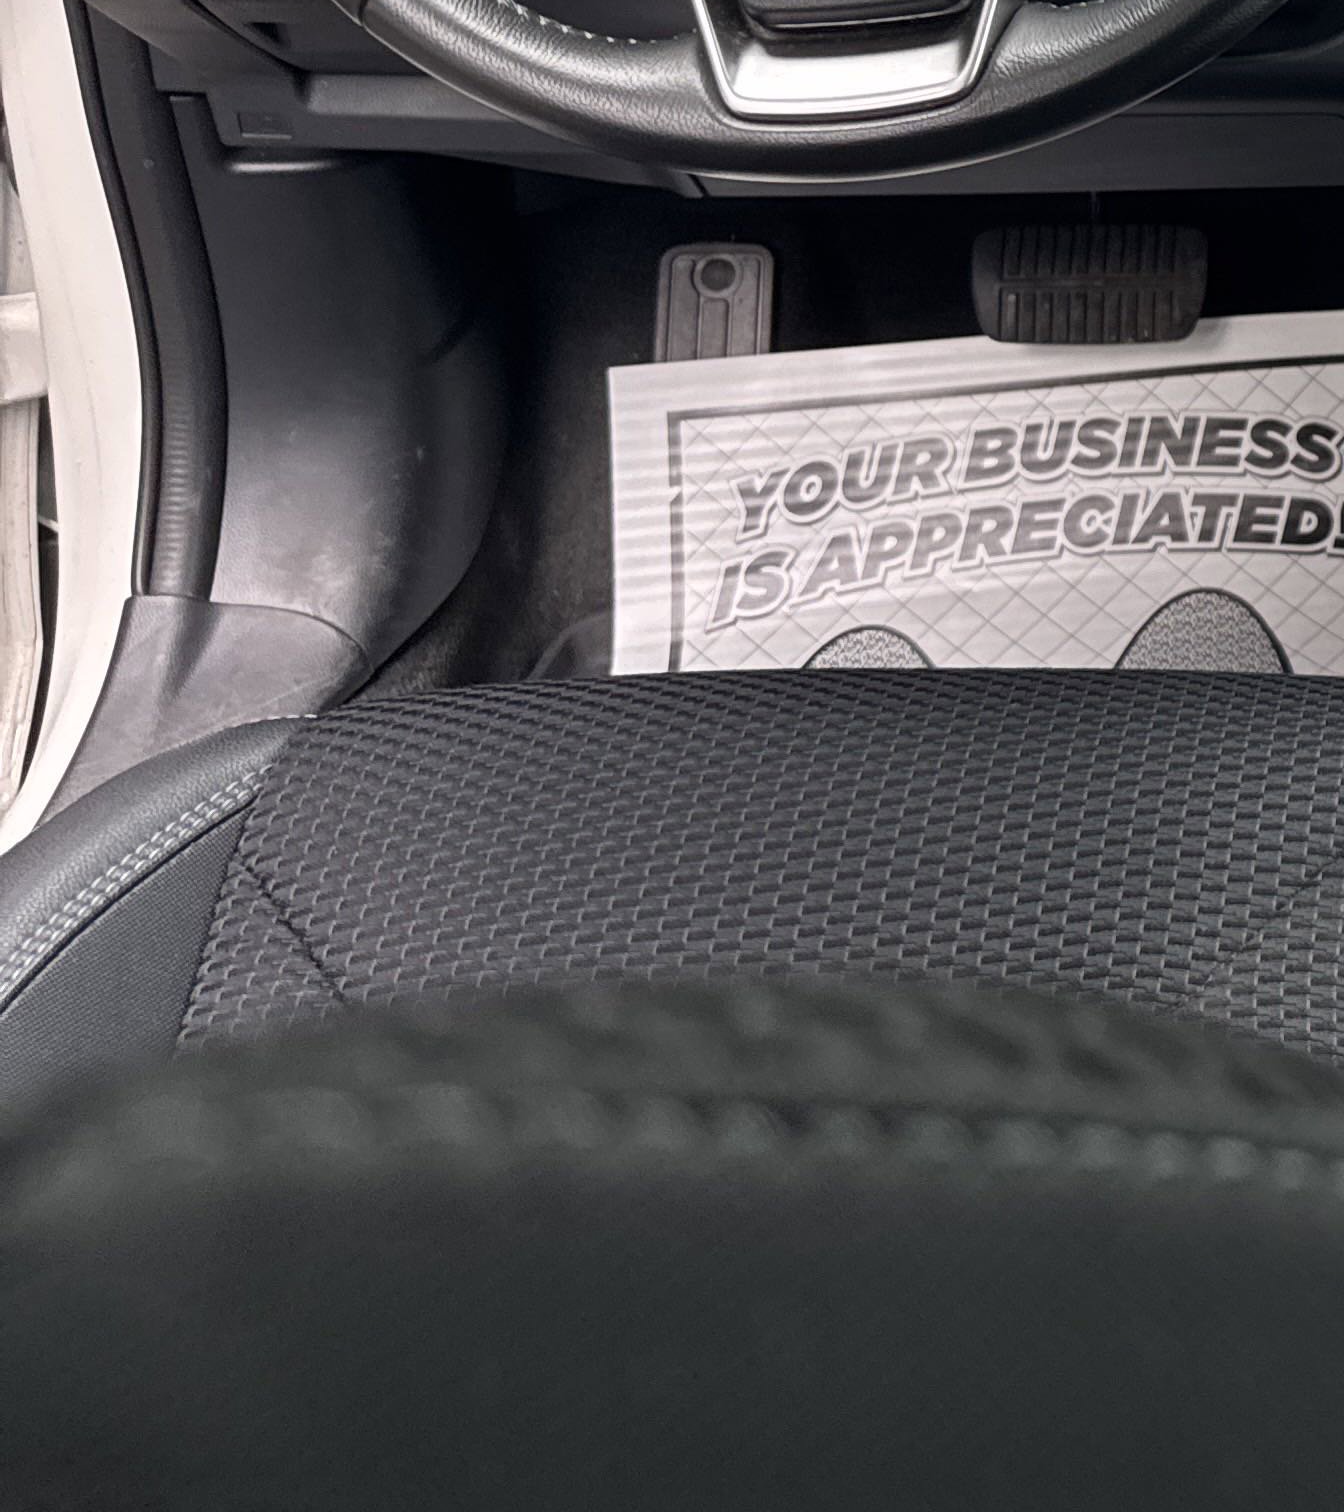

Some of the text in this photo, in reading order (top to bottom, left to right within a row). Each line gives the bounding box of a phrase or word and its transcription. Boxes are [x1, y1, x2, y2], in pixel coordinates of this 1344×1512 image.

[733, 414, 1342, 537] YOUR BUSINESS
[709, 549, 797, 626] IS
